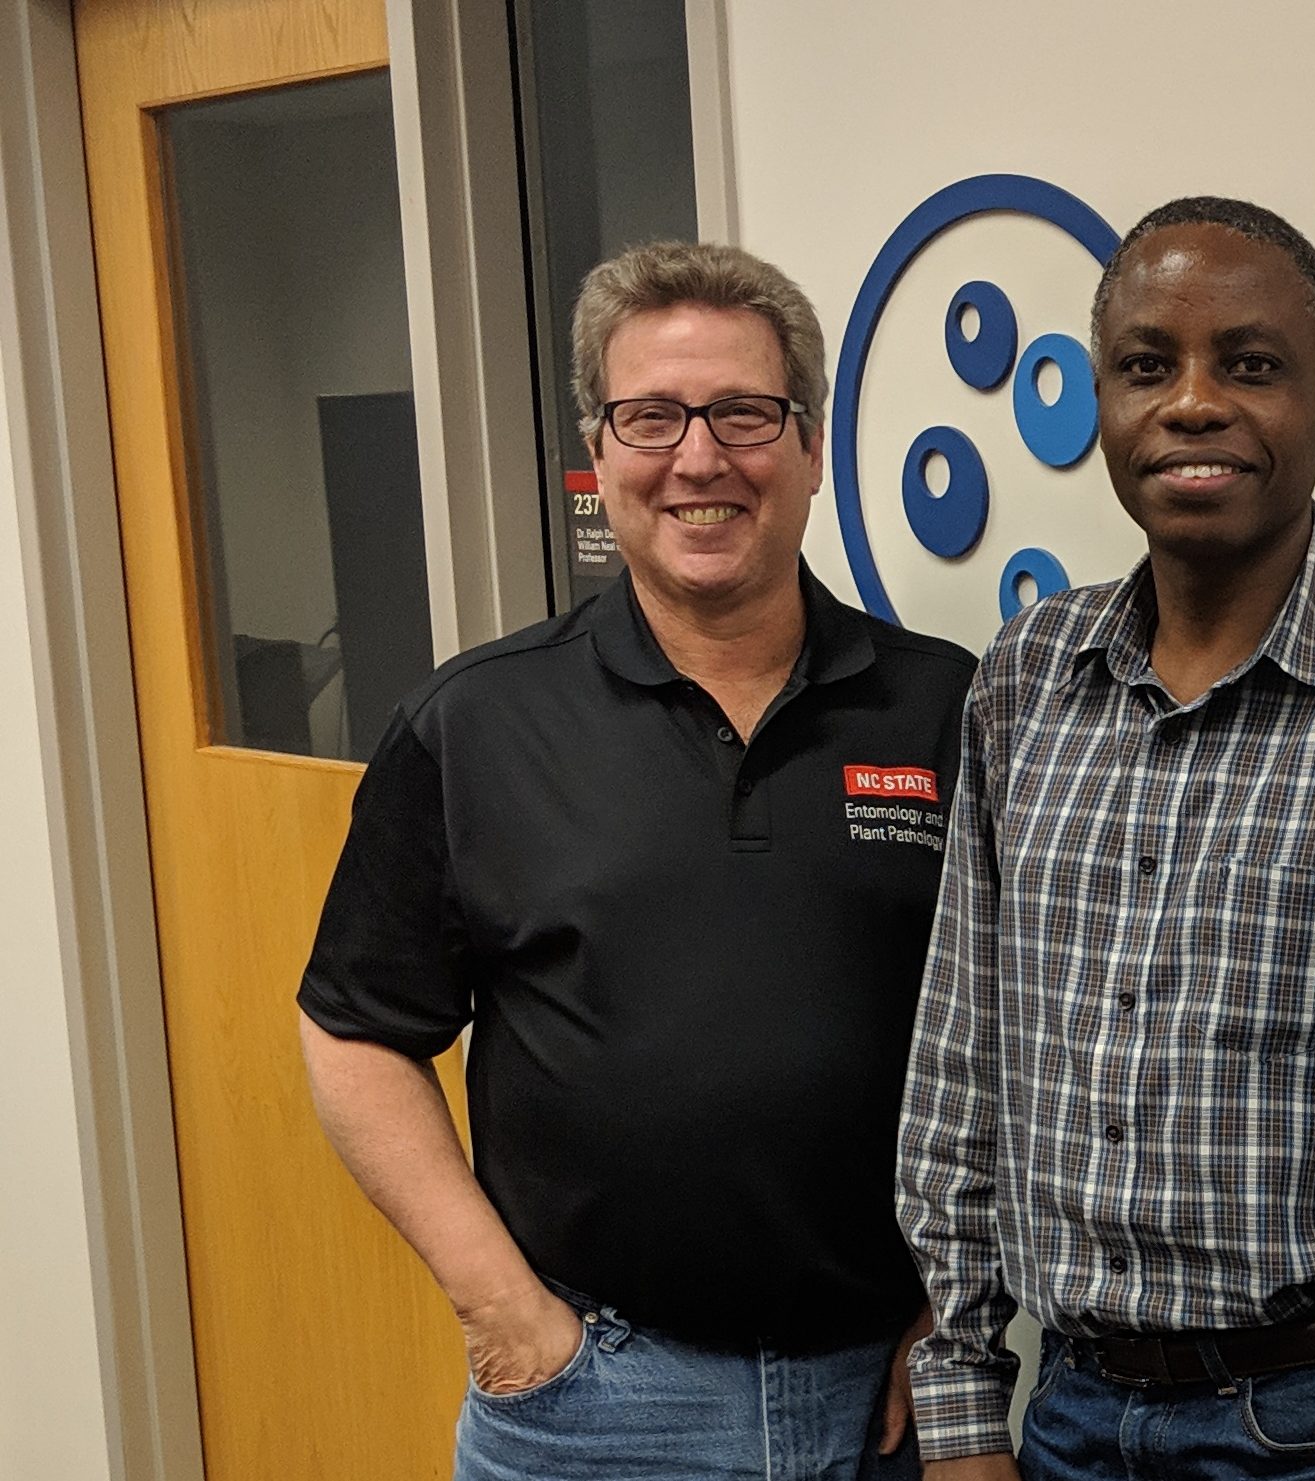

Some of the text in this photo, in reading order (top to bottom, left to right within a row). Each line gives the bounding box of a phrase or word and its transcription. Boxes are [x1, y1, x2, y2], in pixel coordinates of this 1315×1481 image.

[574, 494, 600, 515] 237
[577, 540, 601, 551] William
[578, 552, 607, 563] Professor
[856, 772, 932, 794] NC STATE
[845, 802, 944, 828] Entomology and
[849, 824, 944, 852] Plant Pathology
